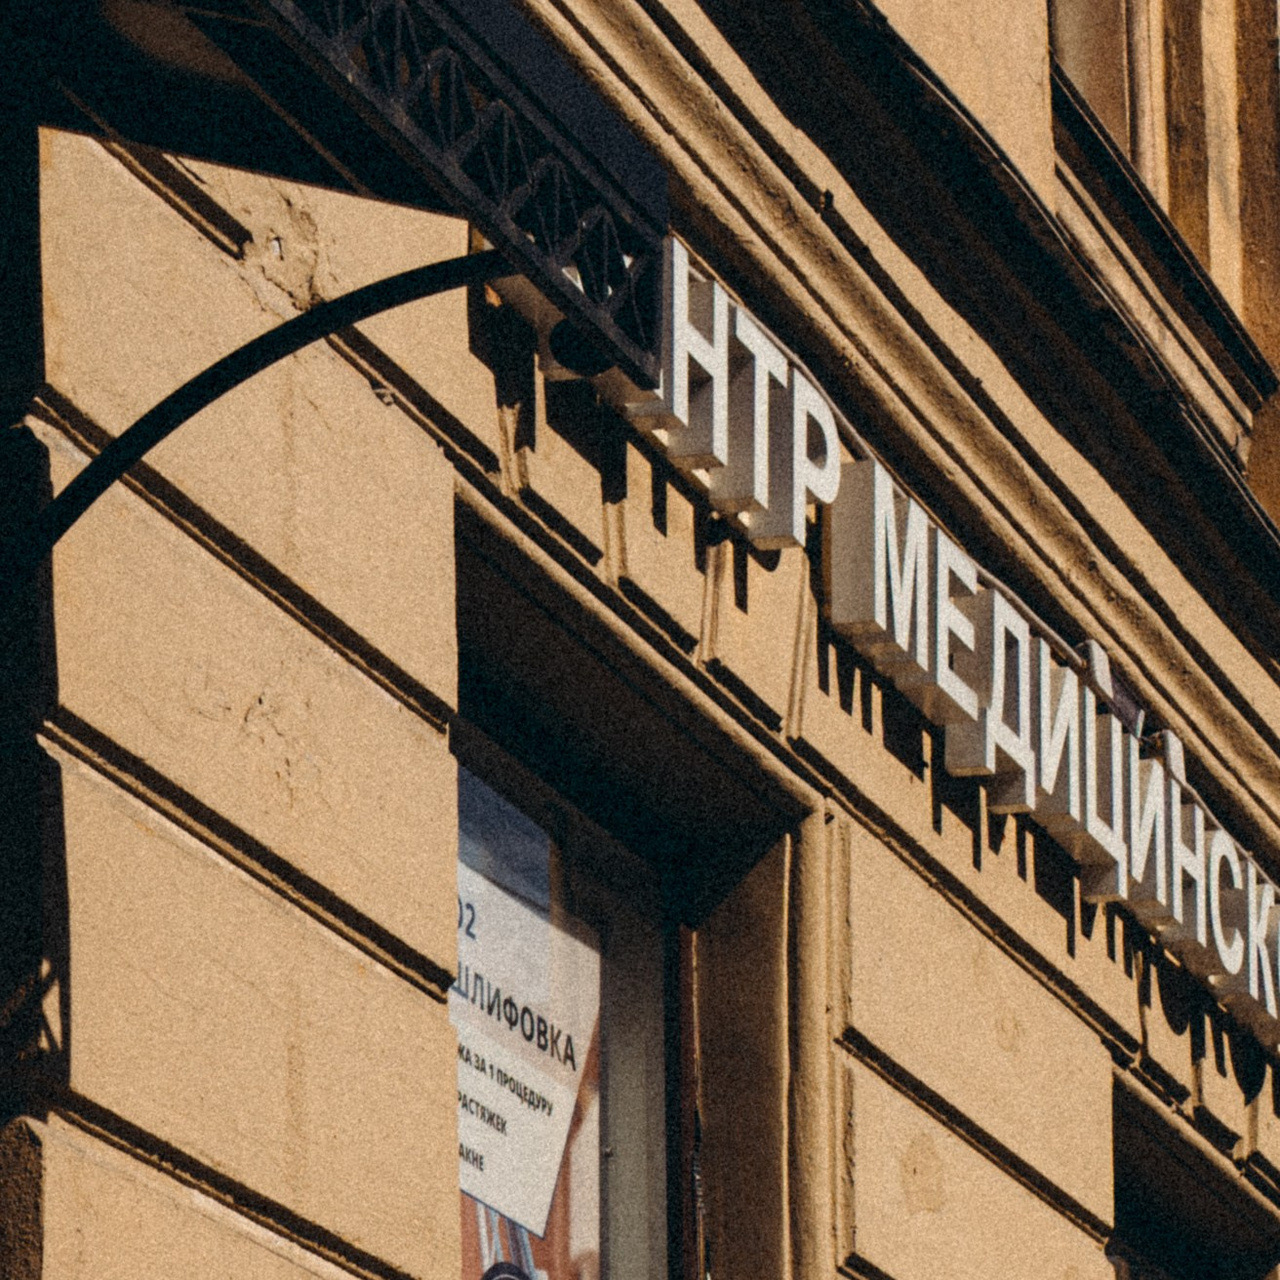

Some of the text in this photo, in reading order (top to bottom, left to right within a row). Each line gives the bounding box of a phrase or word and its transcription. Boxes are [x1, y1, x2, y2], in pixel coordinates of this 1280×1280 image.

[657, 236, 841, 548] НТР
[474, 1053, 487, 1075] ЗА
[496, 1068, 553, 1117] ПРОЦЕДУРУ
[458, 1142, 484, 1172] АКНЕ
